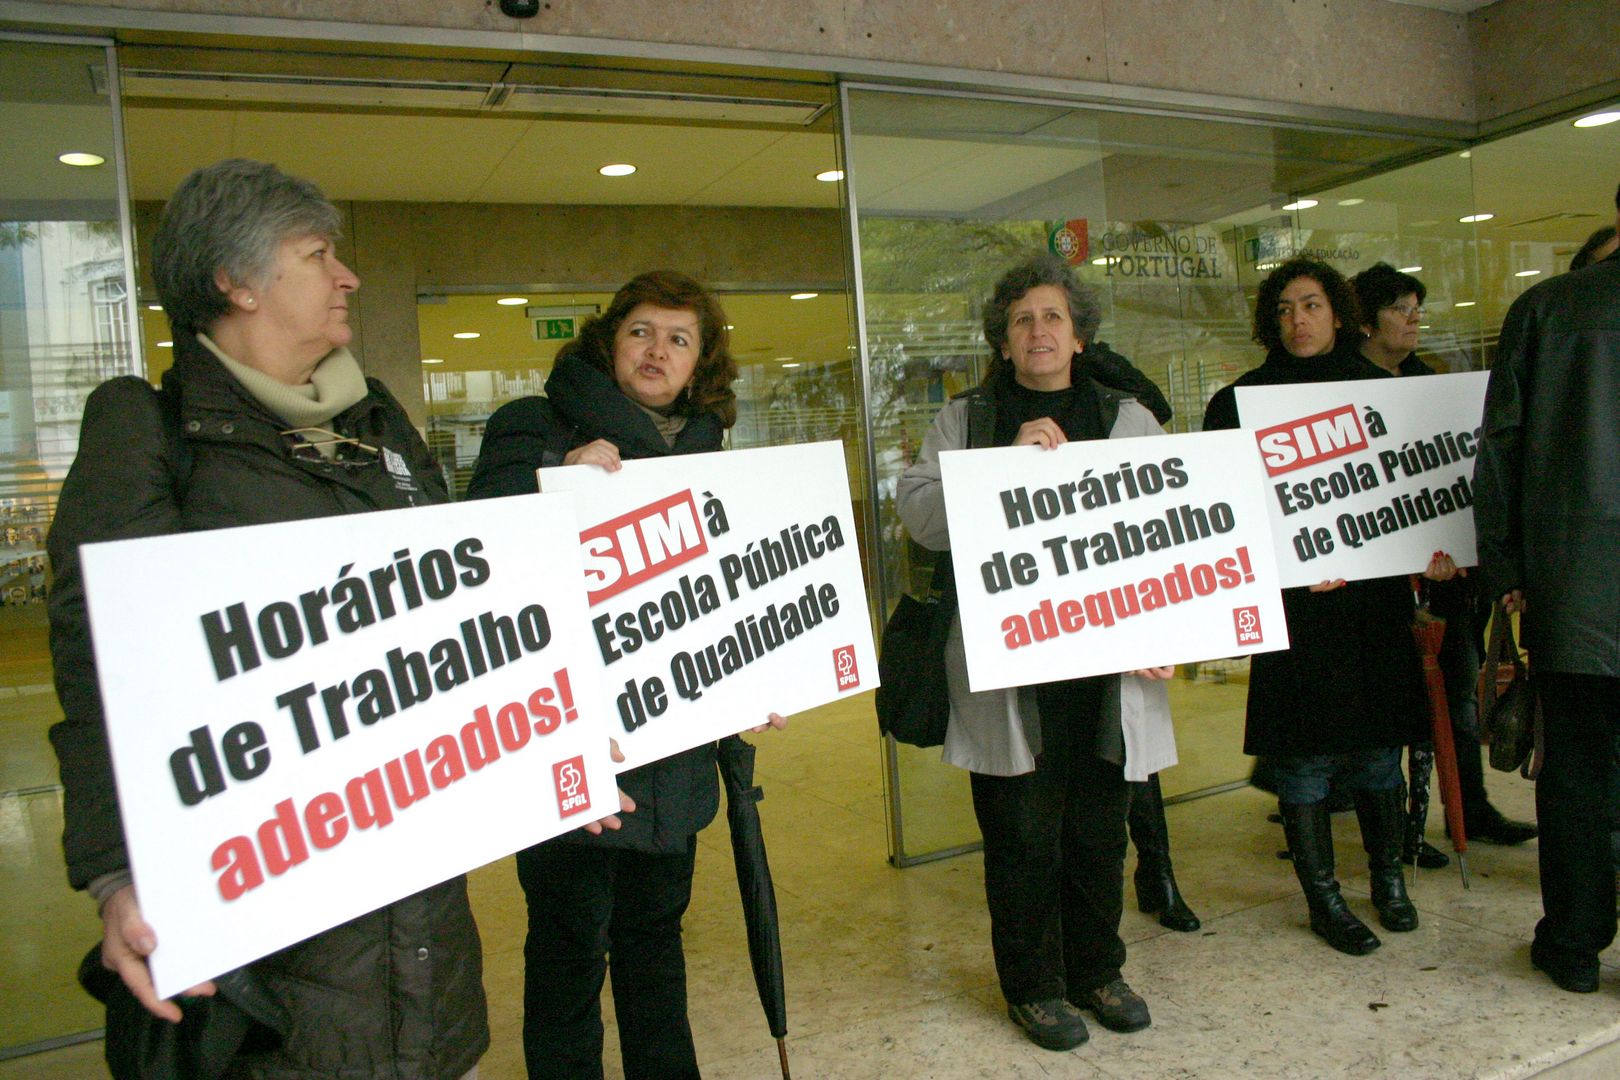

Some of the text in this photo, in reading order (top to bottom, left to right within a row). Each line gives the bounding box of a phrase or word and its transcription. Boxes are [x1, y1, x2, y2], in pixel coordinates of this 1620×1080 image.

[1102, 233, 1217, 256] GOVERNO DE
[1105, 254, 1222, 279] PORTUGAL
[1259, 405, 1388, 468] SIM à
[999, 457, 1189, 529] Horários
[1274, 461, 1380, 516] Escola
[1292, 475, 1475, 562] de Qualidad
[579, 490, 730, 593] SIM à
[980, 501, 1236, 595] de Trabalho
[200, 537, 491, 682] Horários
[591, 514, 845, 666] Escola Pública
[1001, 545, 1256, 650] adequados!
[616, 582, 840, 733] de Qualidade
[168, 603, 552, 807] de Trabalho
[210, 667, 579, 902] adequados!
[562, 793, 588, 811] SPGL
